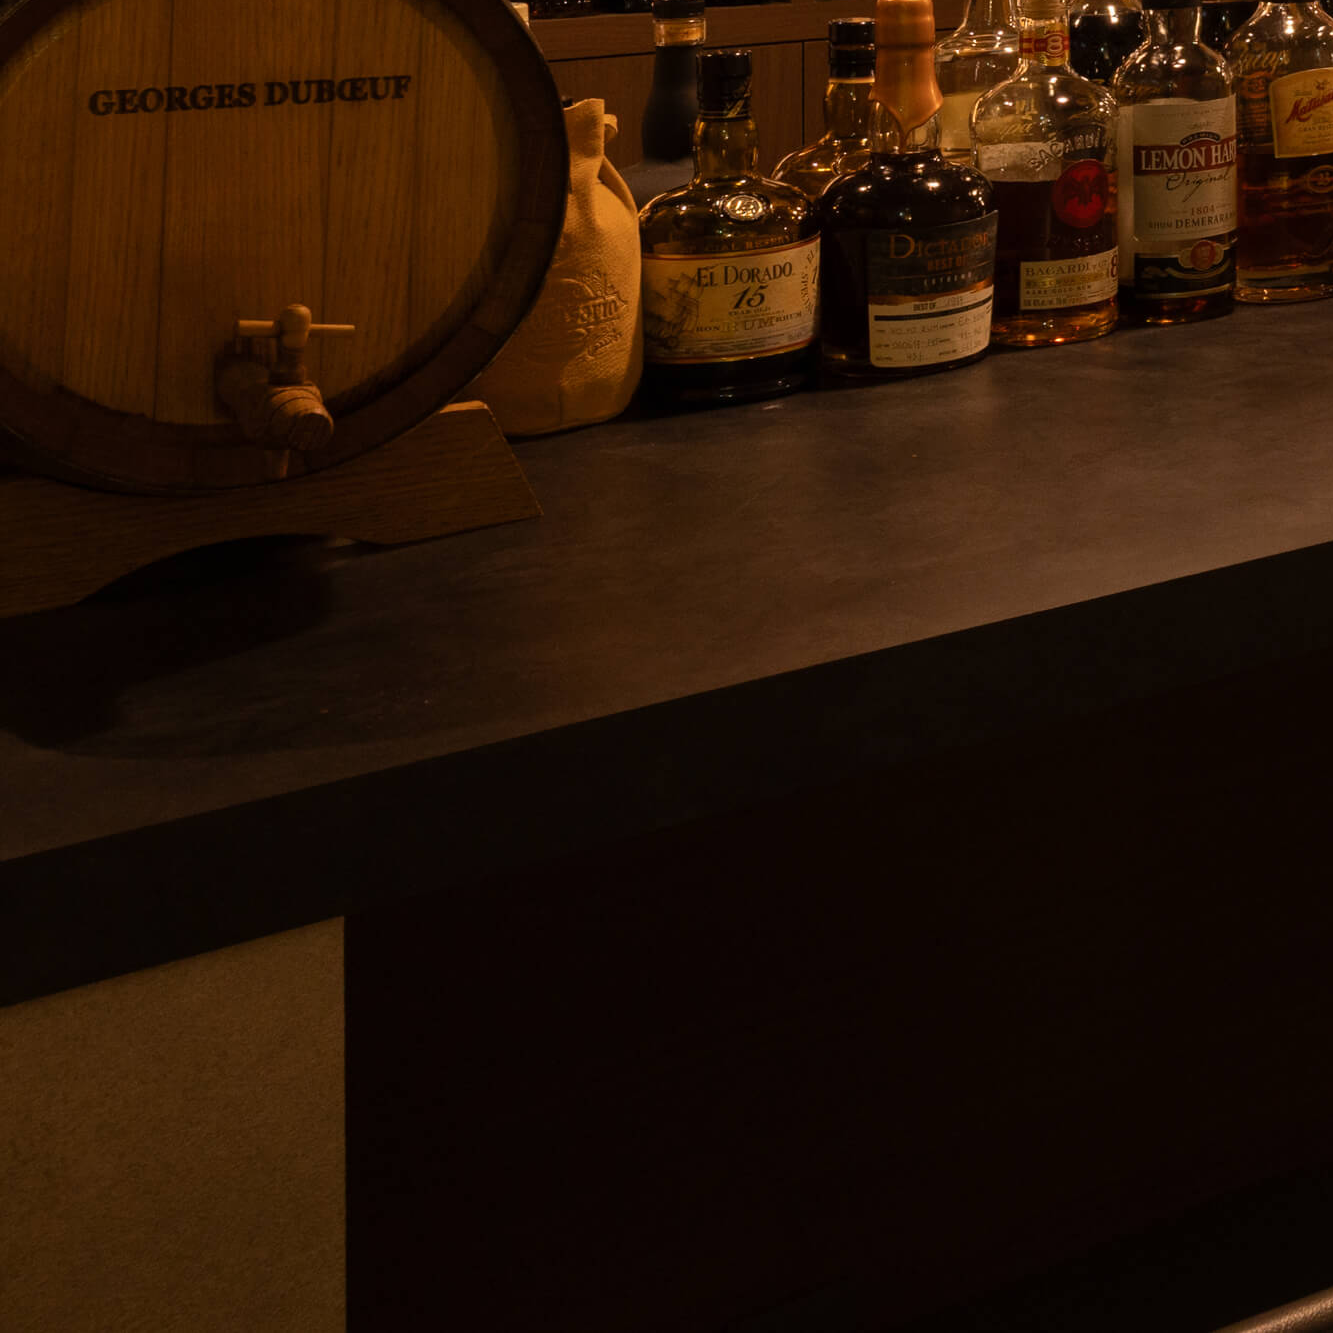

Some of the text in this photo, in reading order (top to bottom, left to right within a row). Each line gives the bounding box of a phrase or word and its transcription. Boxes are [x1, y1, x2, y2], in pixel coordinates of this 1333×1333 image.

[1047, 30, 1063, 57] 8
[88, 82, 257, 116] GEORGES
[1140, 146, 1207, 171] LEMON
[1166, 166, 1232, 203] Original
[724, 261, 793, 286] DORADO
[1024, 262, 1090, 277] BACARDI
[733, 284, 768, 310] 15
[913, 303, 928, 312] BEST
